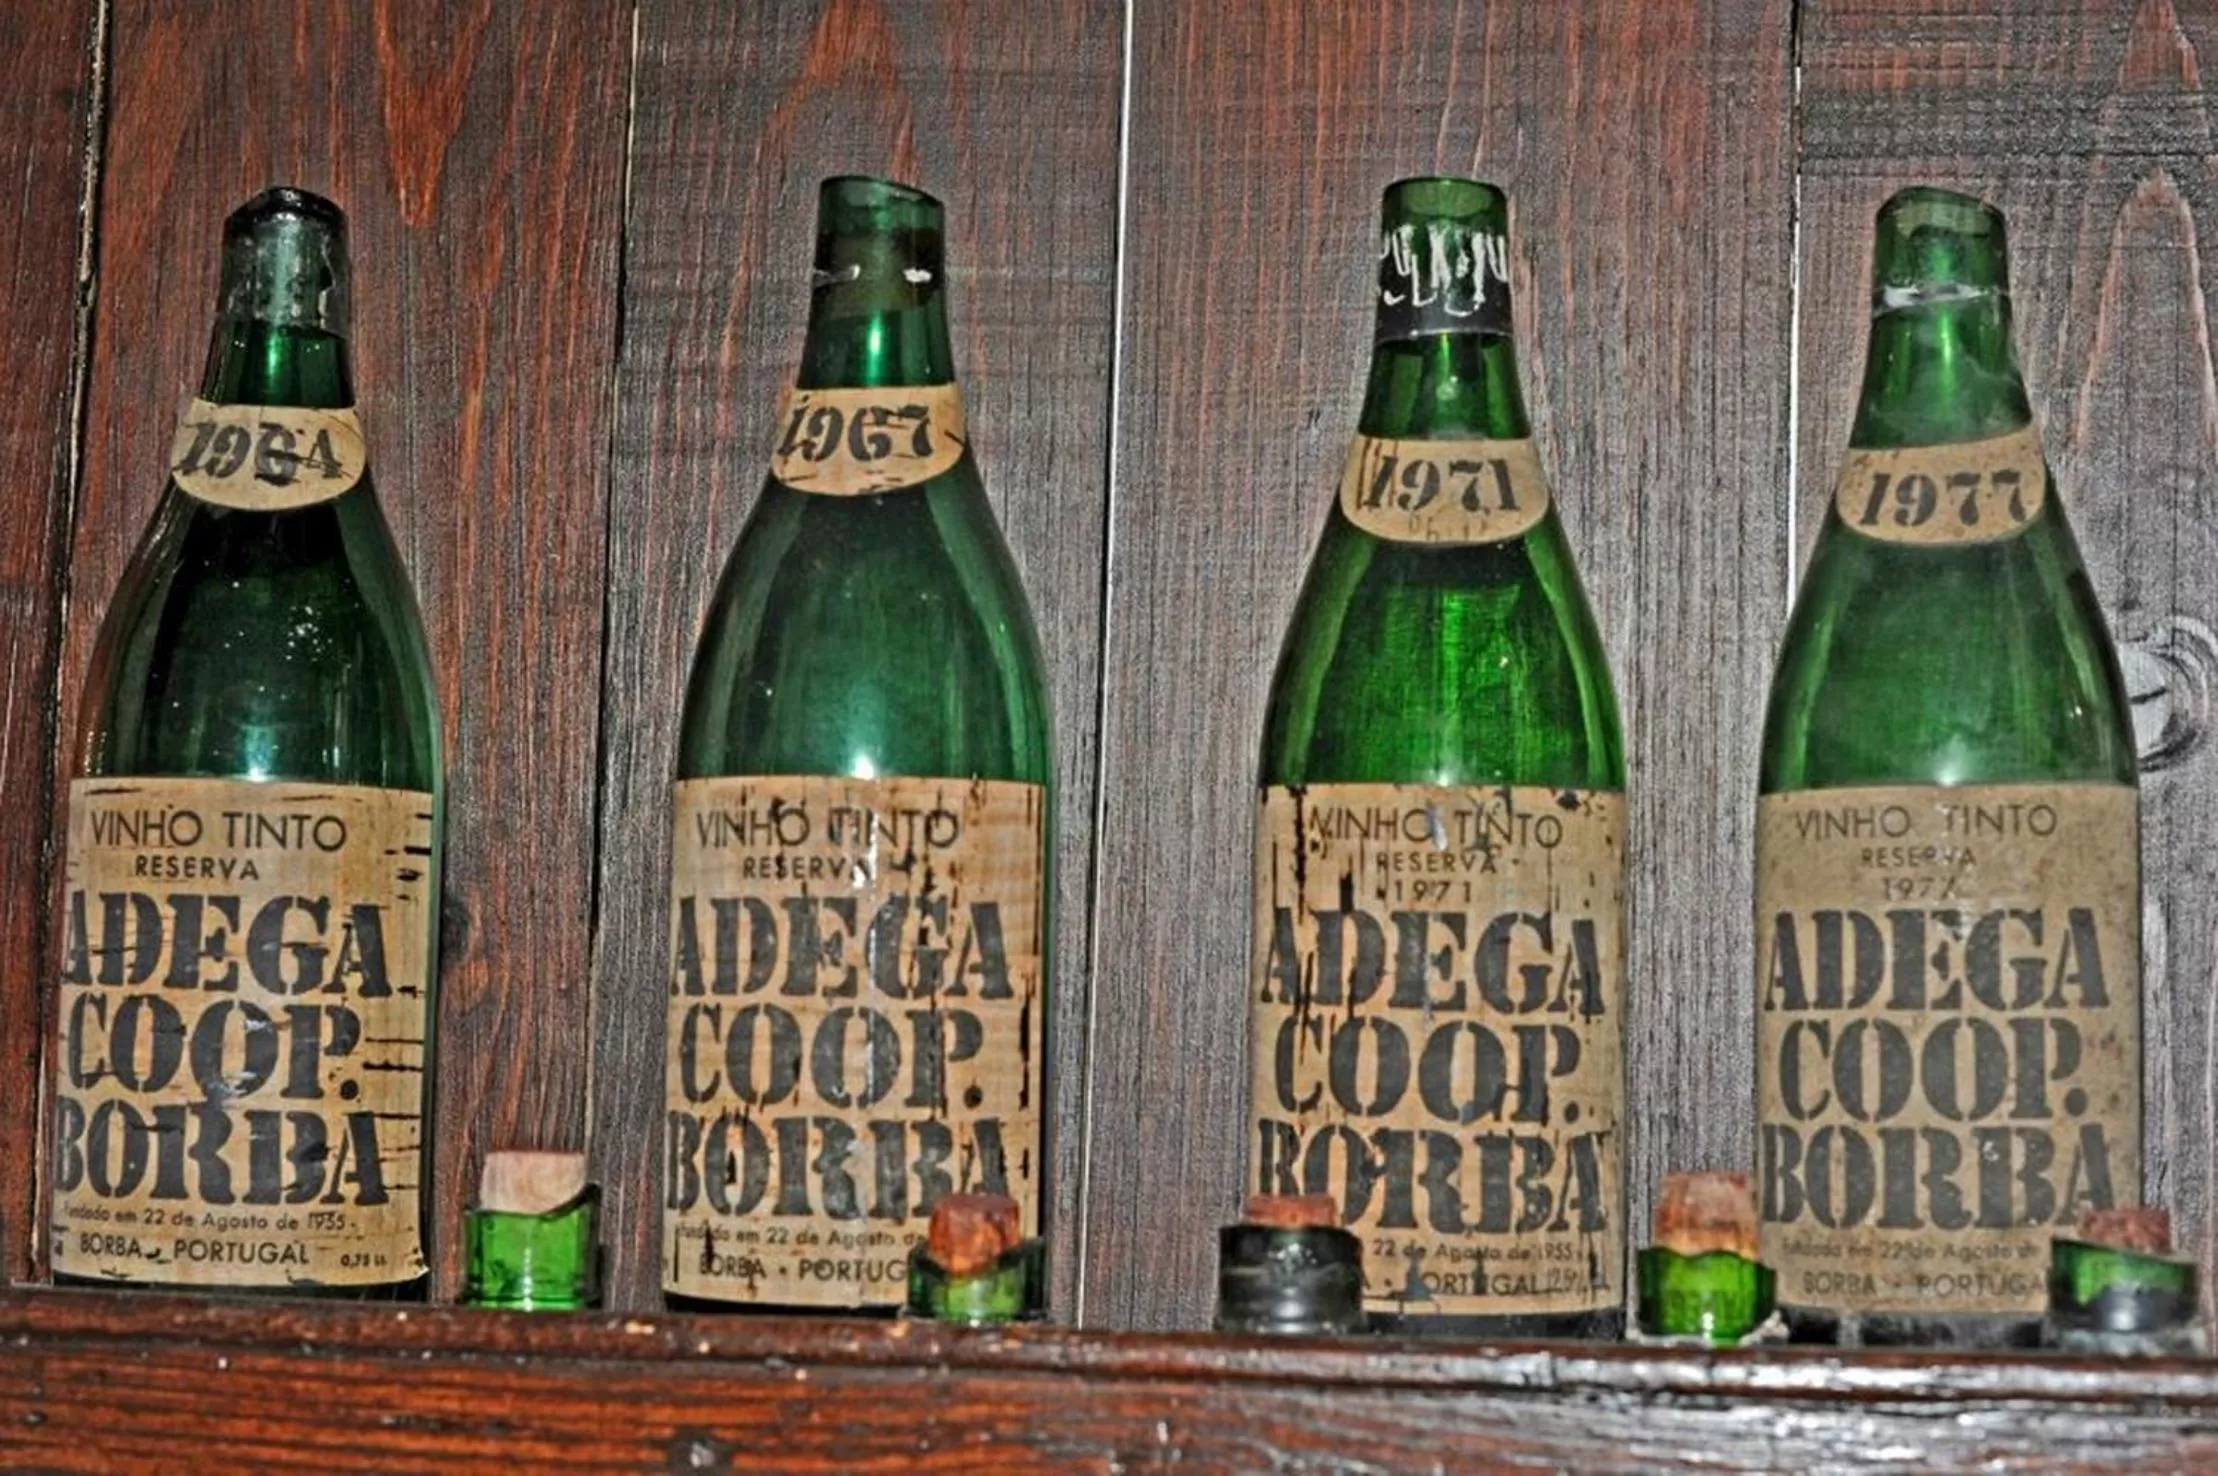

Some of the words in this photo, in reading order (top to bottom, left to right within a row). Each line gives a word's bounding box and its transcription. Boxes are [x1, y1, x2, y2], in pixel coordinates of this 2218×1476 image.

[778, 404, 934, 462] 1967
[1364, 456, 1520, 513] 1971
[1860, 468, 2026, 527] 1977
[92, 809, 203, 848] VINHO
[222, 811, 348, 852] TINTO
[697, 806, 811, 848] VINHO
[828, 806, 960, 849] TINTO
[1309, 804, 1434, 843] VINHO
[1455, 809, 1563, 849] TINTO
[1796, 804, 1912, 841] VINHO
[1944, 804, 2058, 837] TINTO
[135, 855, 260, 881] RESERVA
[743, 855, 871, 880] RESERVA
[1377, 852, 1499, 875] RESERVA
[1861, 846, 1977, 869] RESERVA
[1395, 880, 1474, 903] 1971
[66, 890, 392, 997] ADEGA
[670, 895, 1015, 1000] ADEGA
[1261, 906, 1606, 1015] ADEGA
[1764, 907, 2110, 1011] ADEGA
[69, 992, 361, 1100] COOP.
[681, 1002, 983, 1109] COOP.
[1276, 1014, 1582, 1125] COOP.
[1780, 1017, 2088, 1122] COOP.
[55, 1095, 390, 1205] BORBA
[666, 1110, 1010, 1220] BORBA
[1259, 1118, 1606, 1234] BORBA
[1761, 1123, 2115, 1230] BORBA
[144, 1208, 165, 1225] 22
[171, 1209, 195, 1226] de
[202, 1212, 268, 1232] Agosto
[276, 1213, 299, 1231] de
[737, 1230, 760, 1245] em
[766, 1226, 789, 1245] 22
[796, 1225, 820, 1246] de
[828, 1229, 895, 1251] Agosto
[80, 1232, 142, 1258] BORBA
[174, 1239, 309, 1265] PORTUGAL
[700, 1253, 768, 1279] BORBA
[800, 1257, 907, 1283] PORTUG
[1374, 1240, 1395, 1258] 22
[1437, 1242, 1501, 1265] Agosto
[1507, 1242, 1530, 1260] de
[1942, 1241, 2012, 1264] Agosto
[1803, 1271, 1877, 1297] BORBA
[1916, 1271, 2045, 1298] PORTUGA
